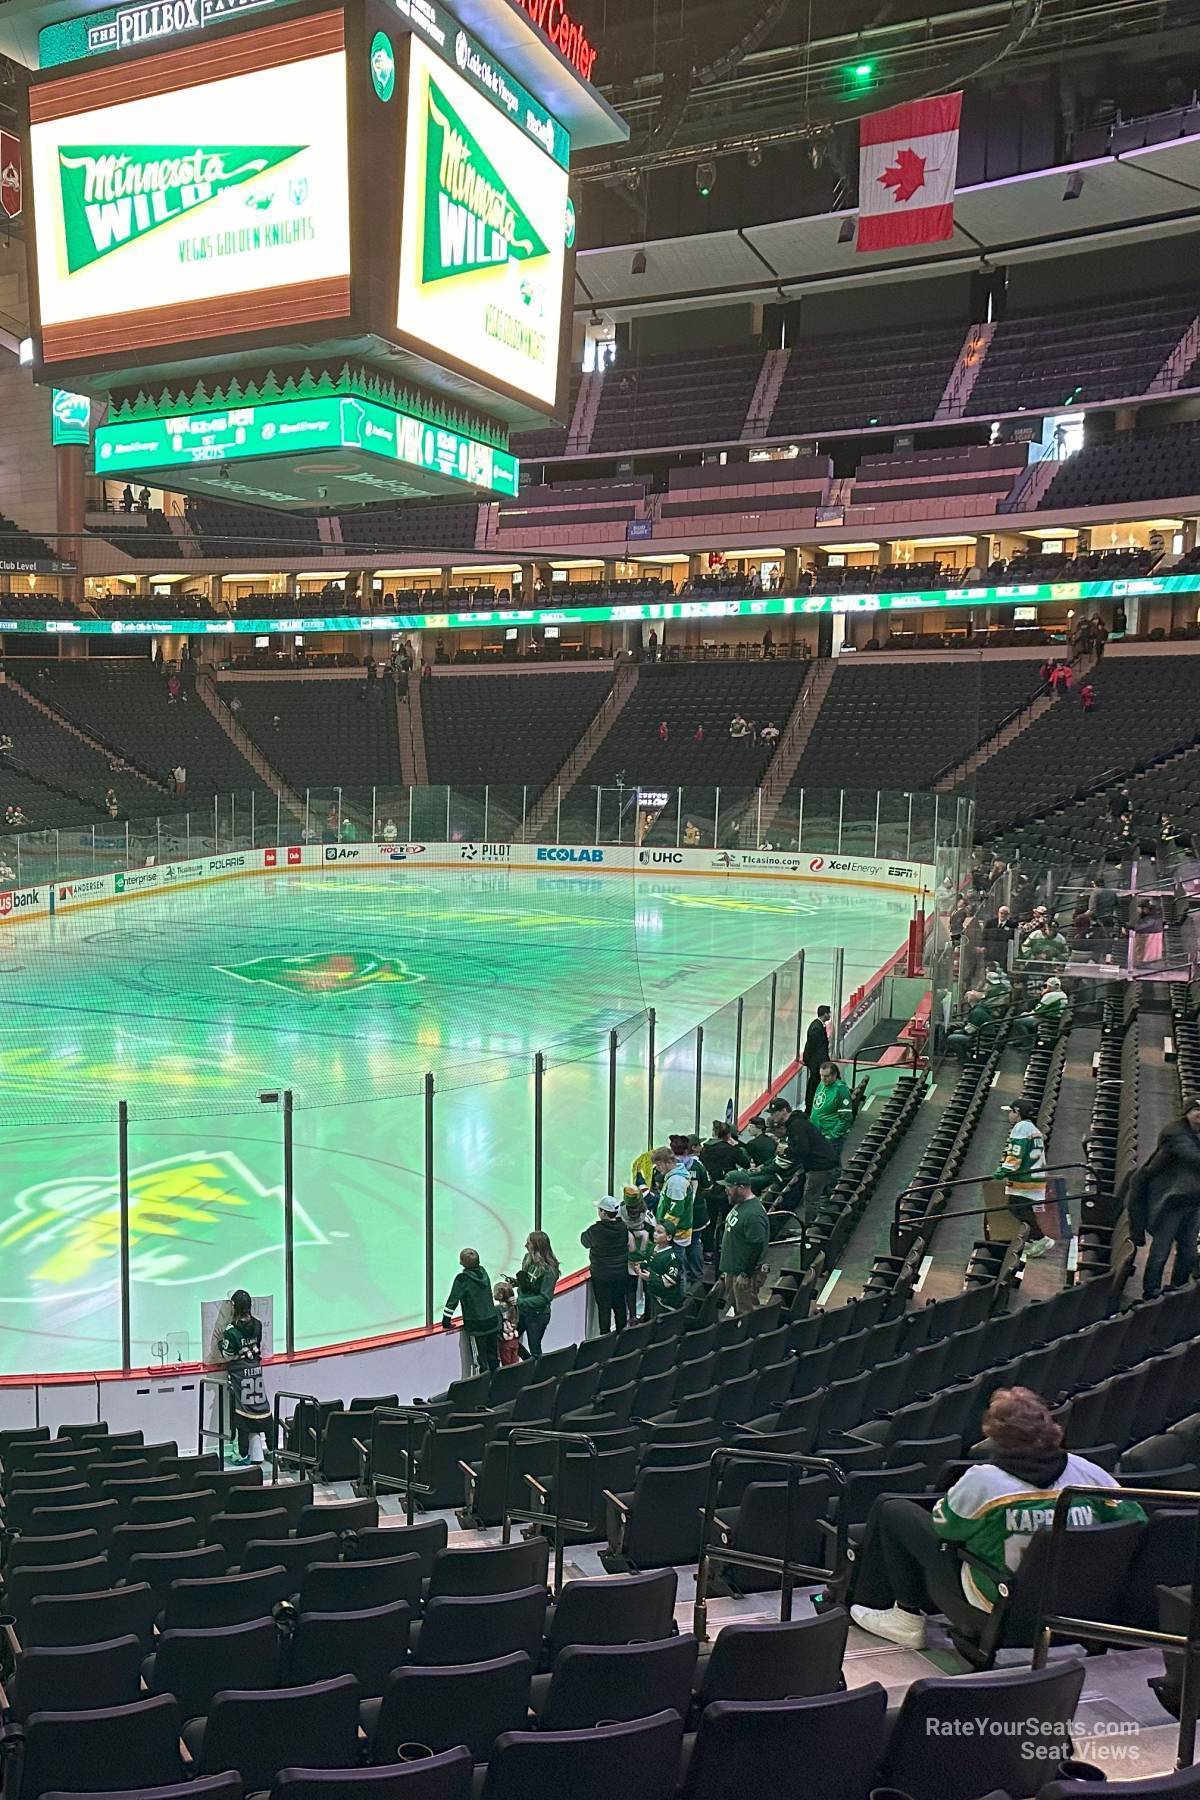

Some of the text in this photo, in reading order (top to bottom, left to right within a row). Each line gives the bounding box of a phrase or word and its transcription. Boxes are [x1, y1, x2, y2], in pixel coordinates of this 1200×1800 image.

[91, 28, 117, 44] THE
[120, 0, 200, 45] PILLBOX
[548, 0, 597, 82] Center
[72, 149, 242, 202] Minnesota
[437, 125, 524, 247] Minnesota
[85, 182, 212, 252] WILD
[177, 216, 315, 263] VEGAS GOLDEN KNIGHTS
[438, 191, 509, 268] WILD
[0, 561, 37, 571] Club Level
[482, 845, 511, 856] PILOT
[536, 848, 604, 862] ECOLAB
[652, 852, 683, 863] UHC
[209, 856, 245, 871] POLARIS
[828, 860, 880, 875] Xcel Energy
[73, 880, 104, 893] ANDERSEN
[116, 872, 157, 889] enterprise
[13, 889, 39, 908] bank
[240, 1378, 267, 1404] 29
[1006, 1506, 1093, 1532] KAPROV
